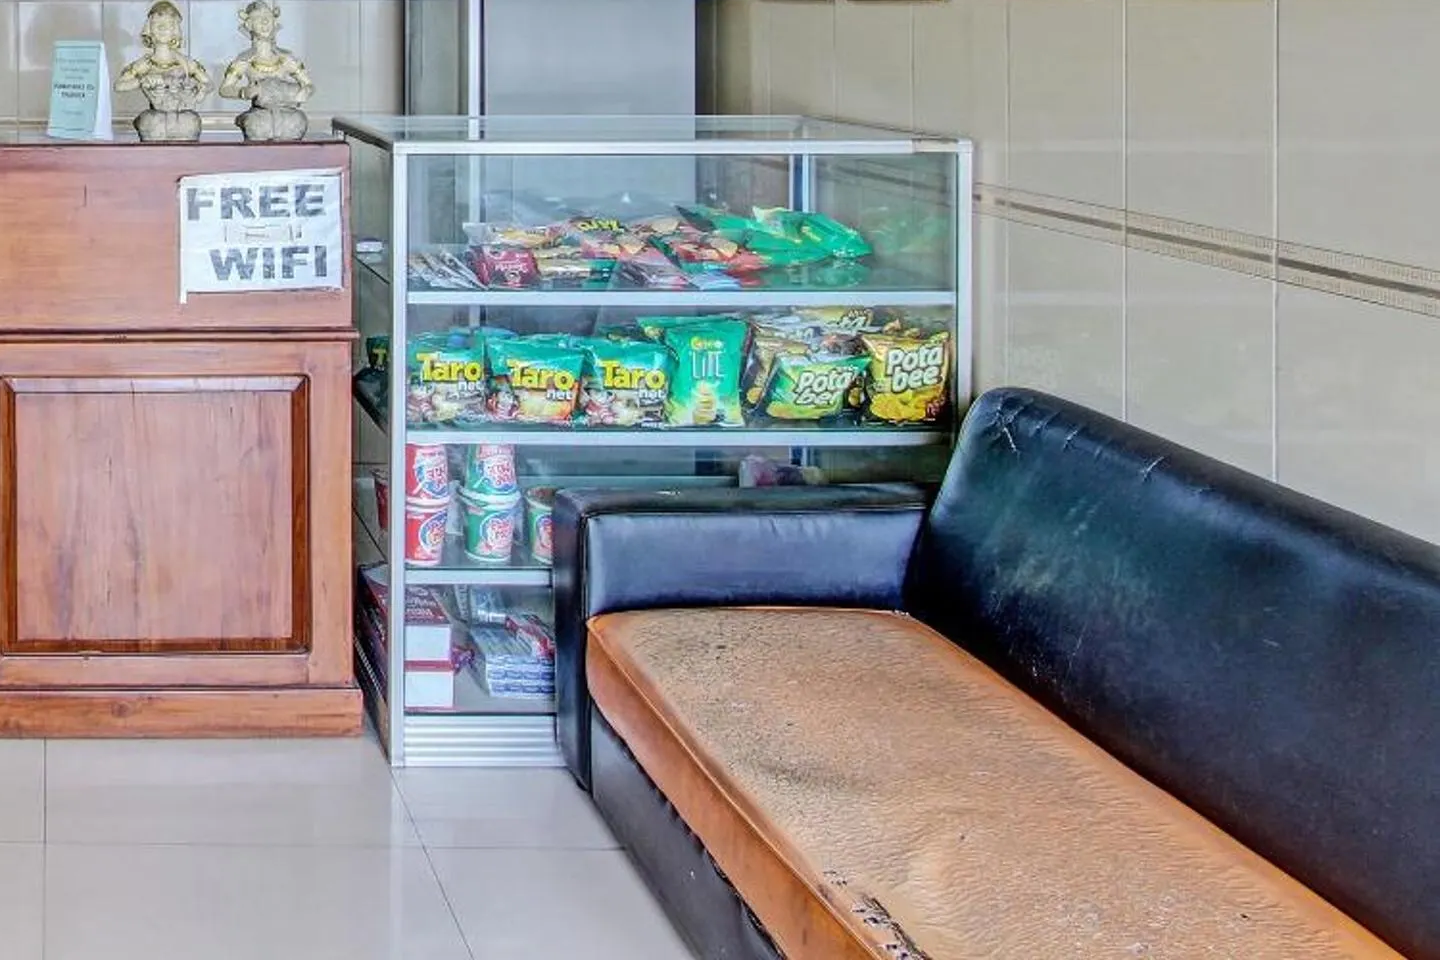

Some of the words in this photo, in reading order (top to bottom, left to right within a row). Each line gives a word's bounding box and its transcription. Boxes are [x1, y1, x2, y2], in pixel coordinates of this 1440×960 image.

[187, 184, 326, 220] FREE
[210, 245, 327, 280] WIFI
[417, 352, 483, 382] Taro
[887, 344, 943, 375] Pota
[506, 359, 575, 391] Taro
[600, 360, 667, 390] Taro
[797, 370, 852, 393] Pota
[892, 366, 941, 393] bee
[547, 388, 574, 401] net
